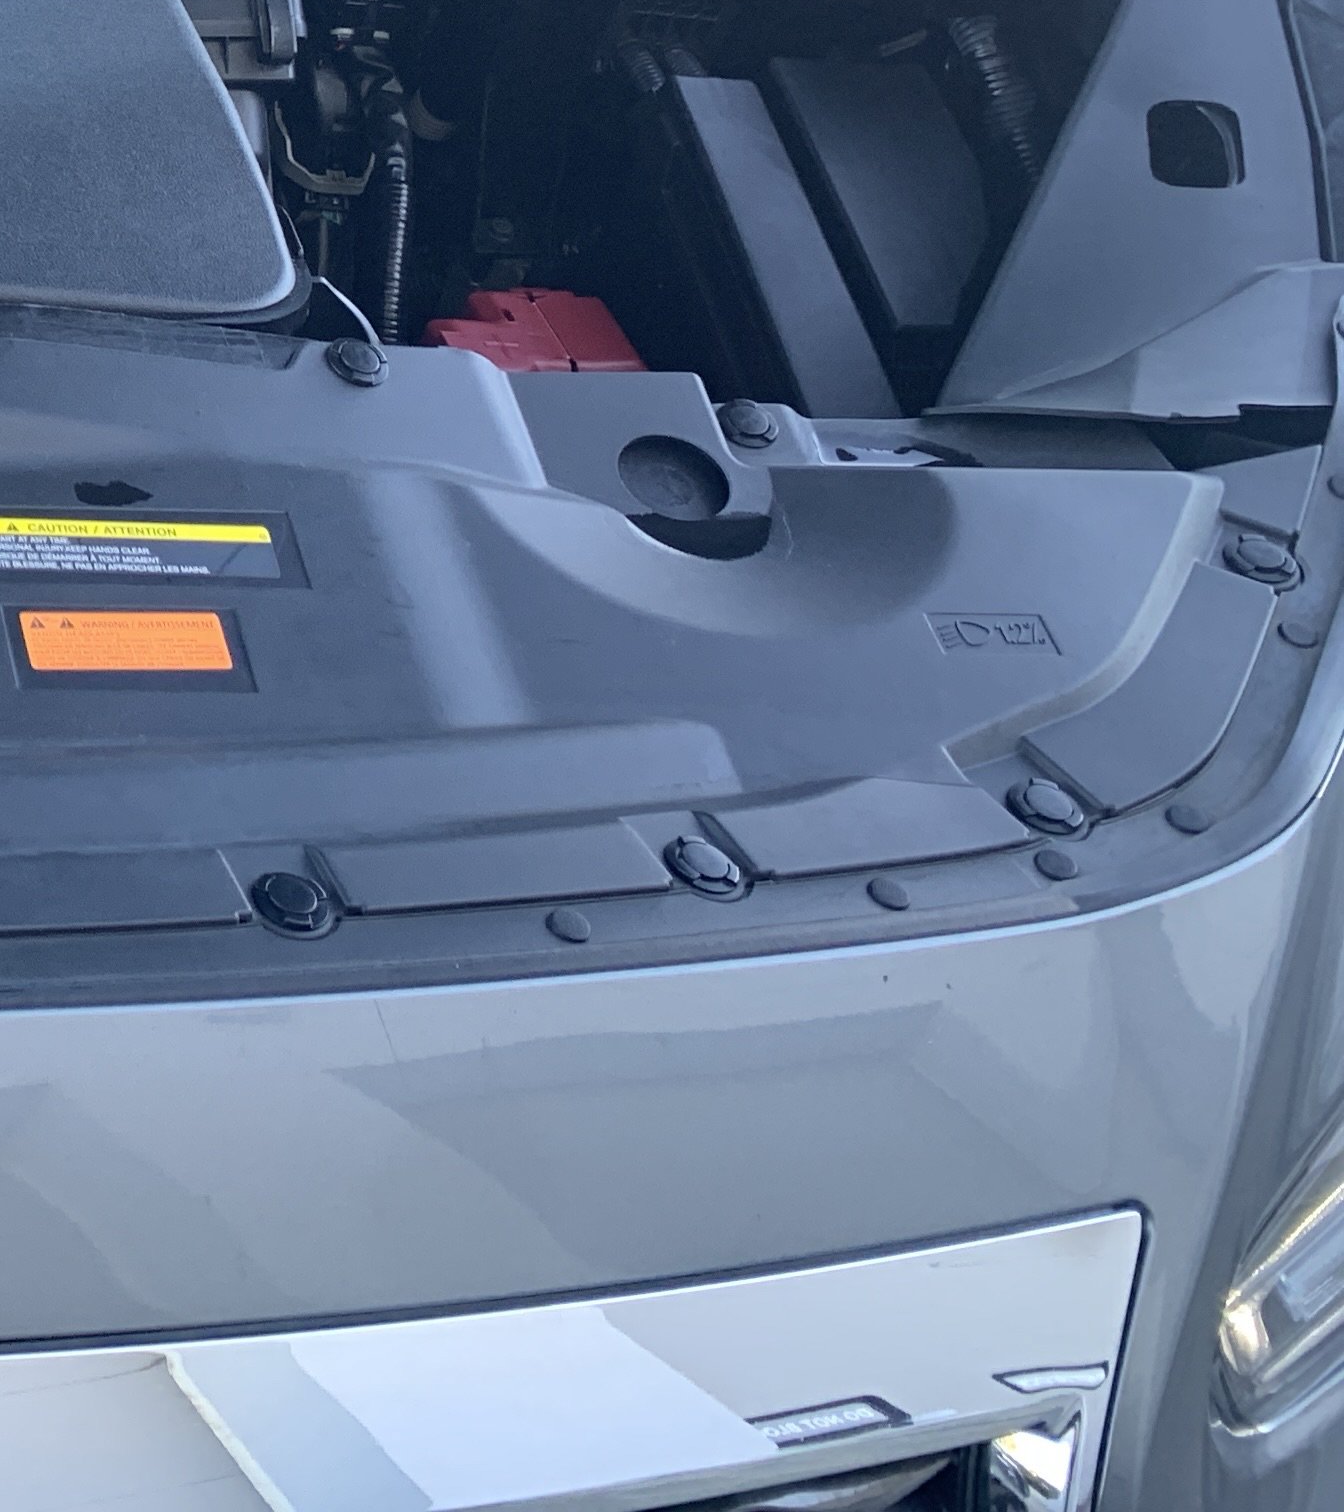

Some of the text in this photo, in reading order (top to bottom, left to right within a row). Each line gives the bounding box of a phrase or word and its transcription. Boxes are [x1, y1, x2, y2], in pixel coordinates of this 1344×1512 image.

[27, 523, 177, 536] CAUTION / ATTENTION
[17, 535, 28, 543] AT
[30, 535, 47, 543] ANY
[88, 545, 120, 554] HANDS
[27, 552, 40, 560] DE
[98, 554, 121, 562] TOUT
[61, 562, 74, 570] NE
[75, 562, 93, 571] PAS
[94, 563, 107, 571] EN
[108, 563, 162, 573] APPROCHER
[163, 565, 180, 573] LES
